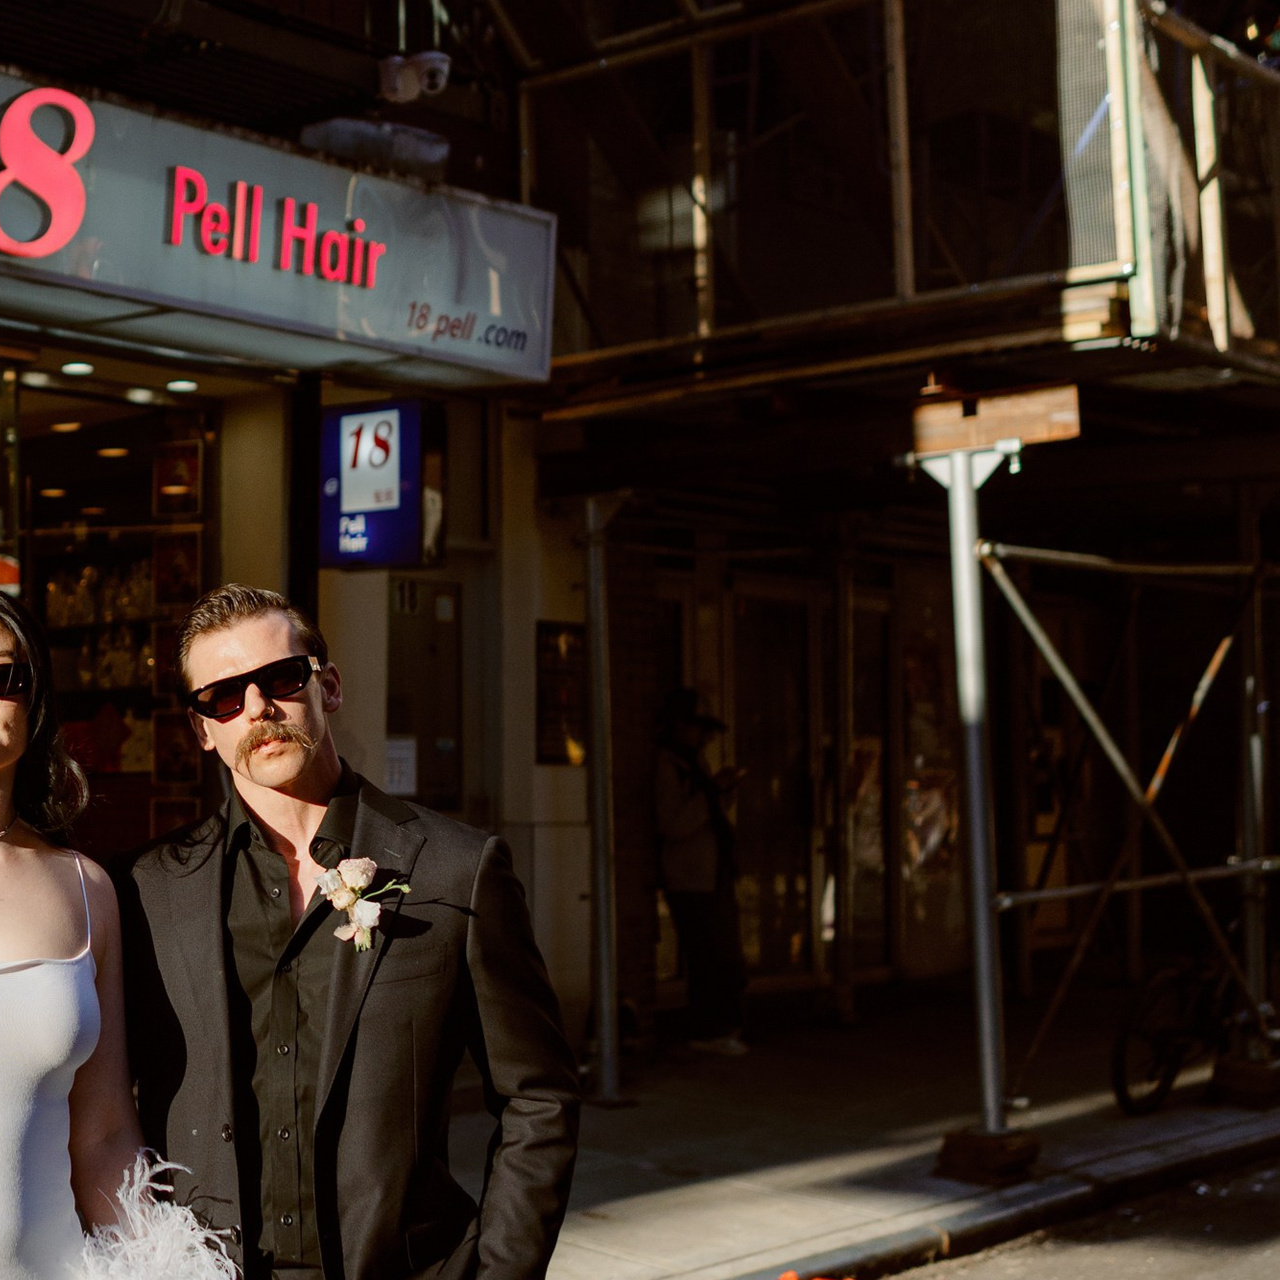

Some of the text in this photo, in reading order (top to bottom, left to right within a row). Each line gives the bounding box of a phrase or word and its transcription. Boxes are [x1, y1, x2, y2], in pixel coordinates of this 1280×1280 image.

[167, 164, 264, 264] Pell
[279, 196, 387, 290] Hair
[406, 300, 528, 353] 18 pell .com
[349, 420, 394, 469] 18
